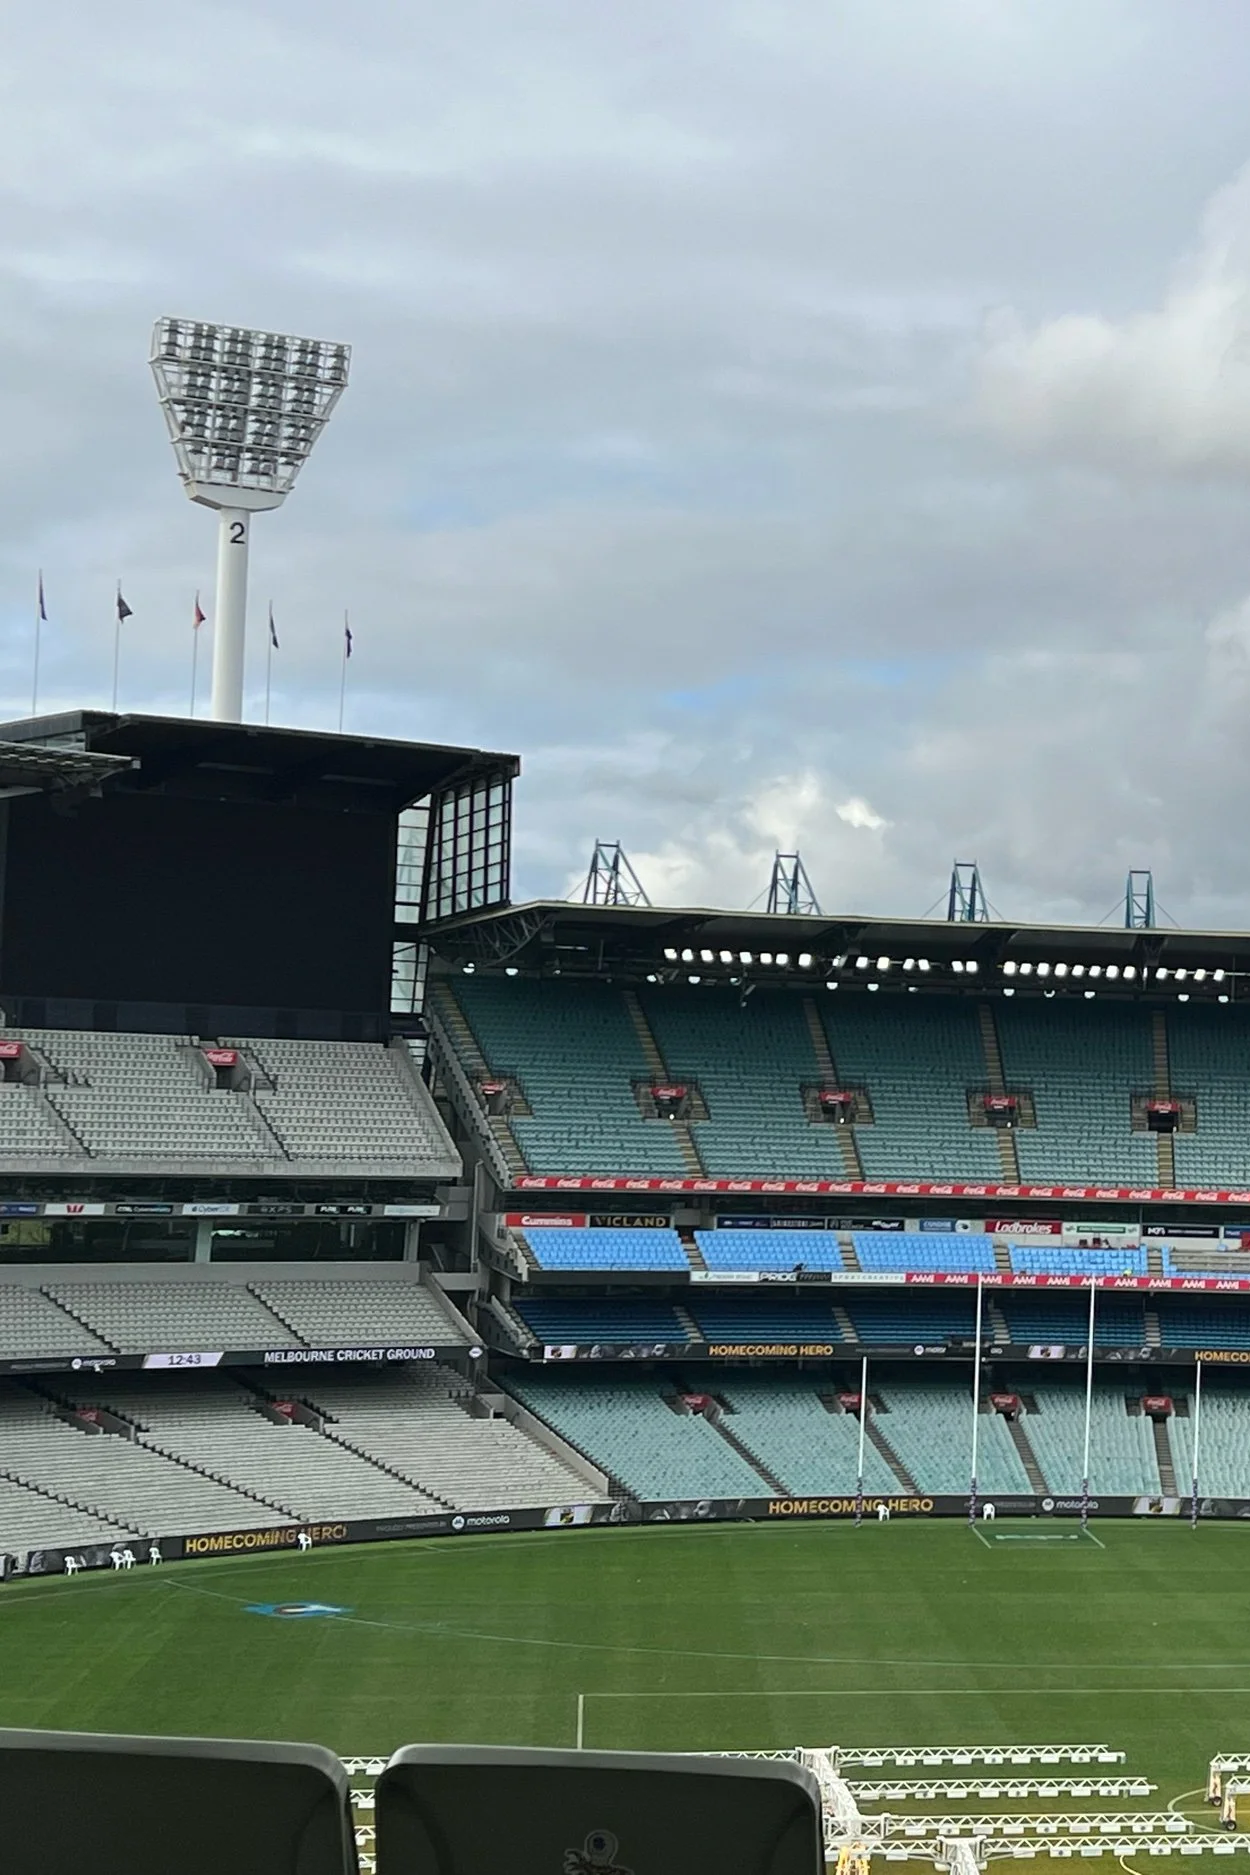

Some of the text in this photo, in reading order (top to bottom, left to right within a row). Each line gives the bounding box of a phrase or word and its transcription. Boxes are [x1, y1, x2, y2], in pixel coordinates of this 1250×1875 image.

[230, 521, 246, 545] 2
[995, 1220, 1052, 1234] Ladbrokes
[264, 1348, 436, 1363] MELBOURNE CRICKET GROUND
[709, 1345, 834, 1356] HOMECOMING HERO
[168, 1355, 201, 1366] 12:43
[888, 1498, 934, 1512] HERO
[467, 1514, 510, 1526] motorola
[185, 1529, 296, 1553] HOMECOMING
